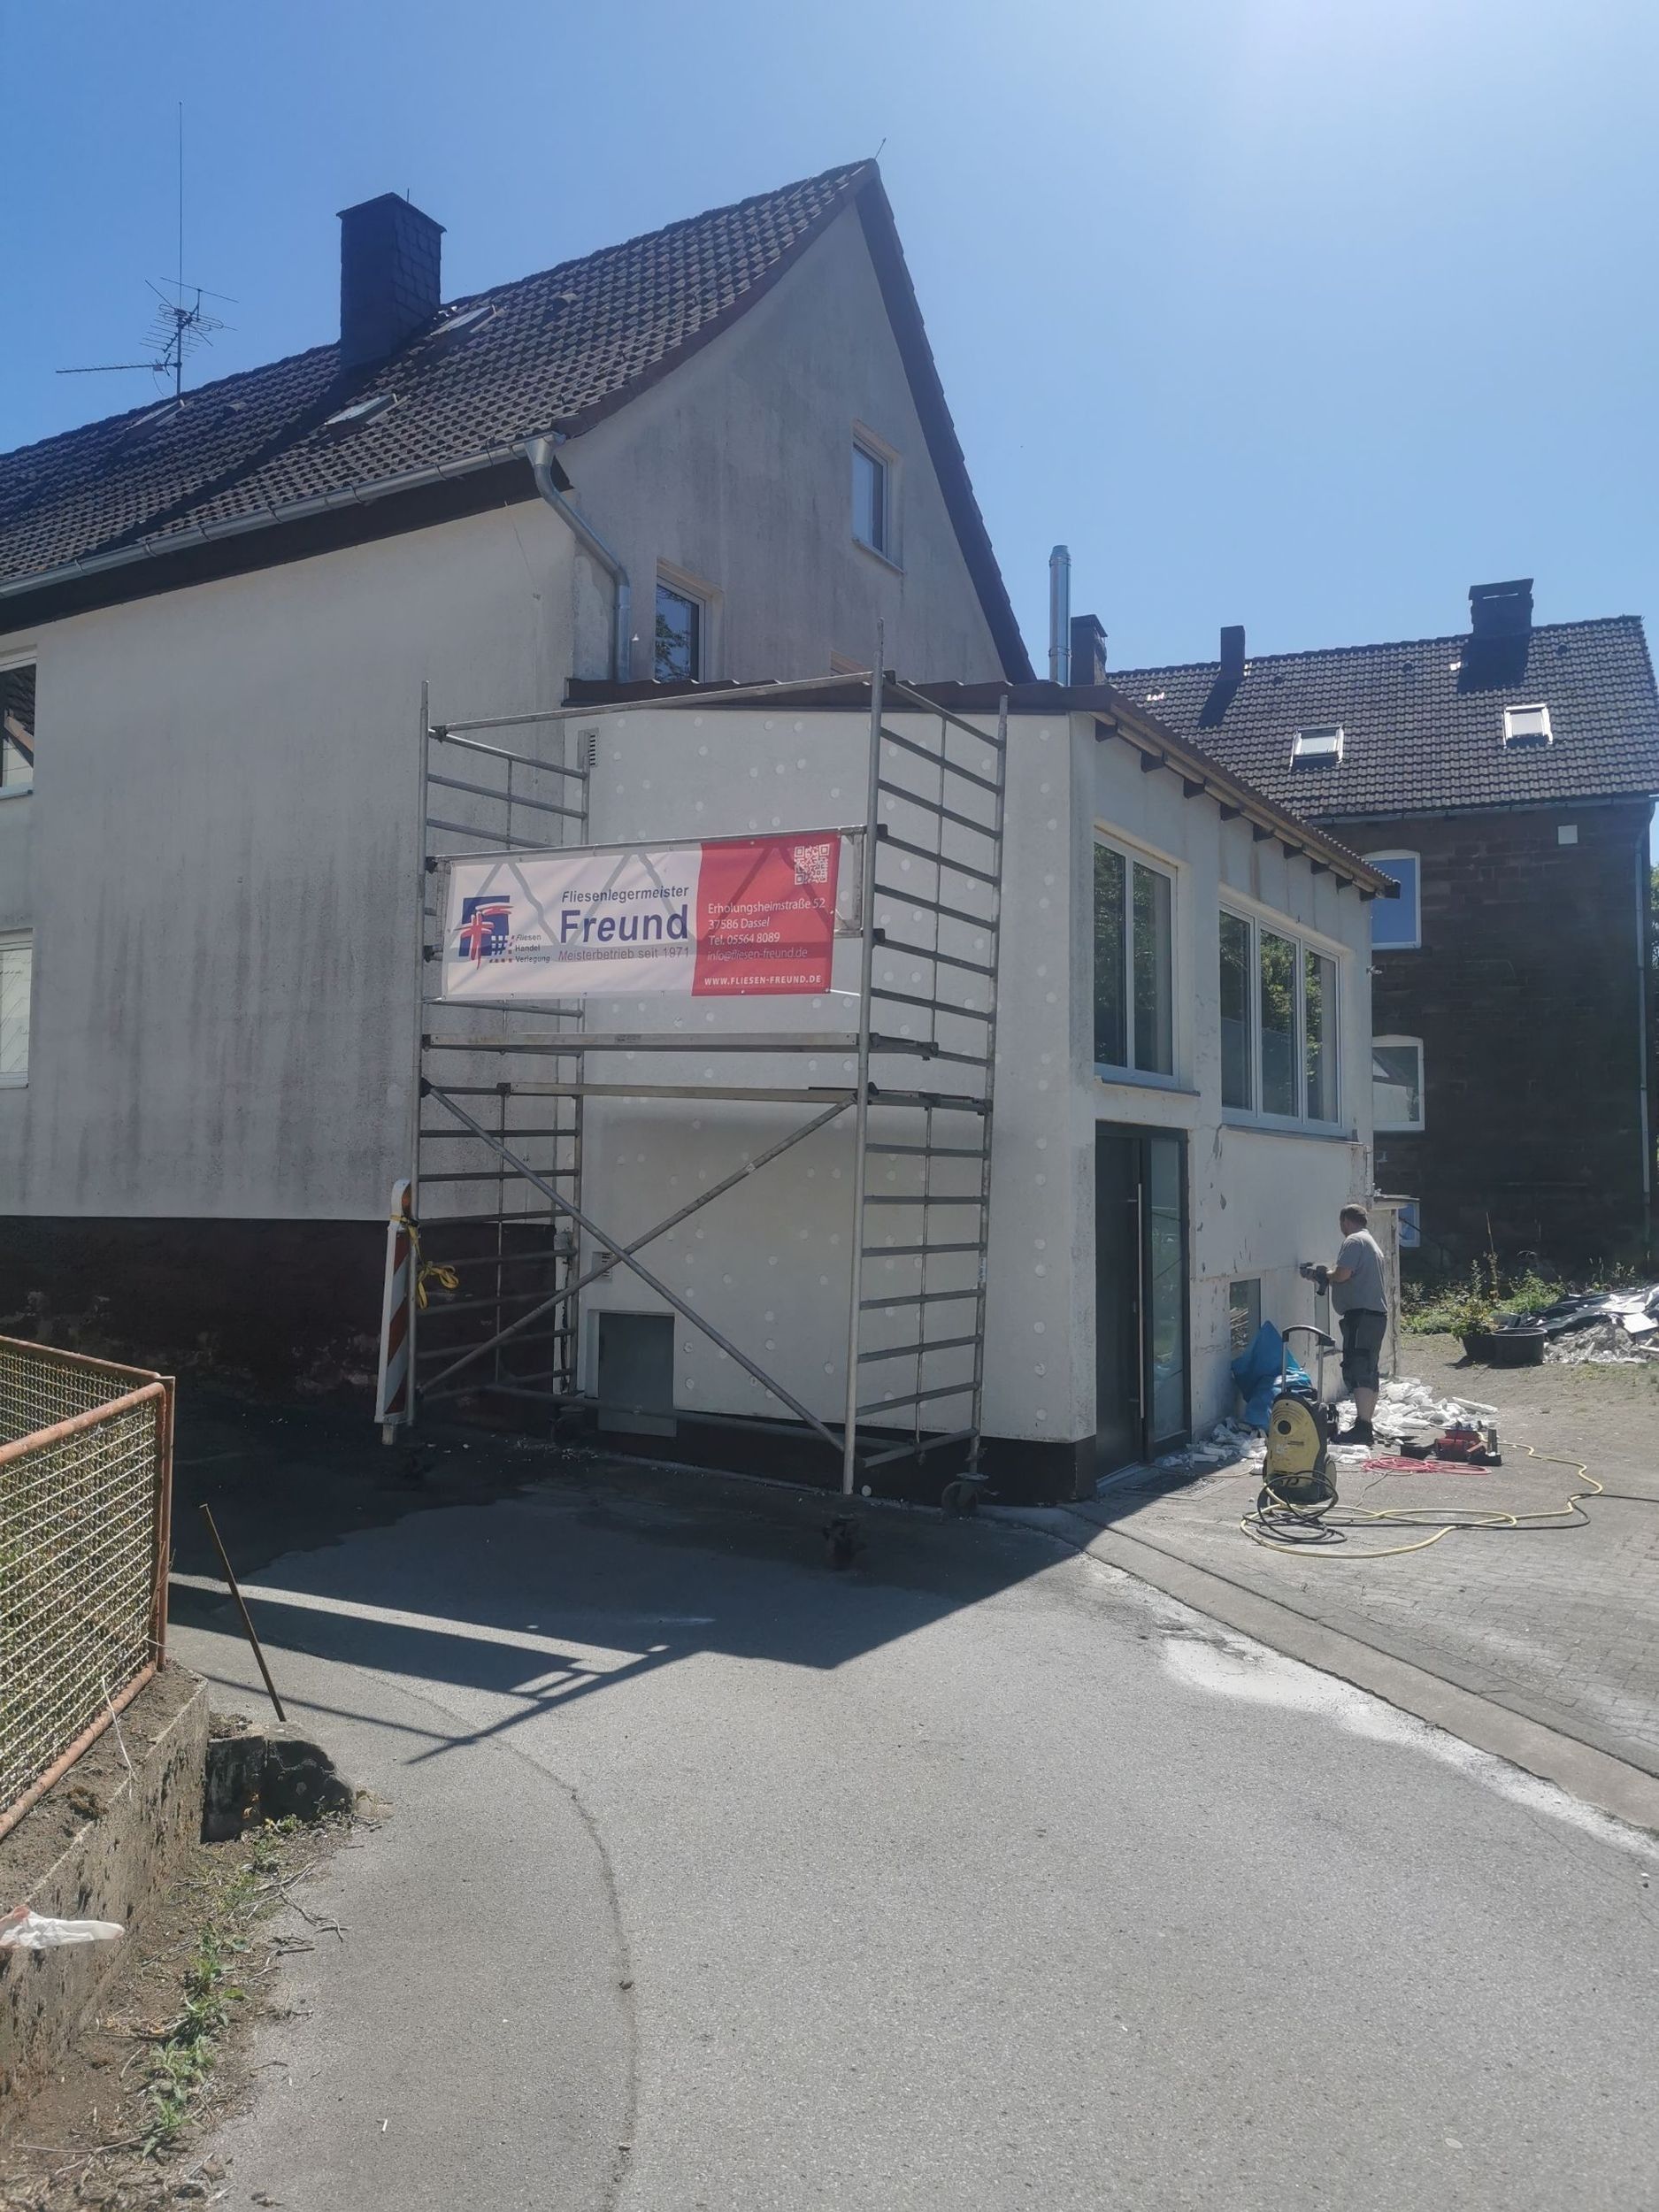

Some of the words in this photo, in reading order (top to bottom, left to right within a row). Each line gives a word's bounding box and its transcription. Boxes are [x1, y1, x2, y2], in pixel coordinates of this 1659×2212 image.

[562, 886, 689, 903] Fliesenlegermeister
[708, 898, 811, 914] Erholungsheimstraße
[812, 898, 826, 909] 52
[560, 904, 688, 944] Freund
[709, 919, 739, 930] 37586
[741, 917, 771, 928] Dassel
[709, 934, 725, 946] Tel.
[726, 933, 754, 945] 05564
[757, 932, 780, 943] 8089
[515, 955, 550, 964] Verlegung
[558, 948, 634, 961] Meisterbetrieb
[638, 948, 658, 958] seit
[663, 947, 689, 958] 1971
[704, 975, 822, 986] WWW.FLIESEN-FREUND.DE
